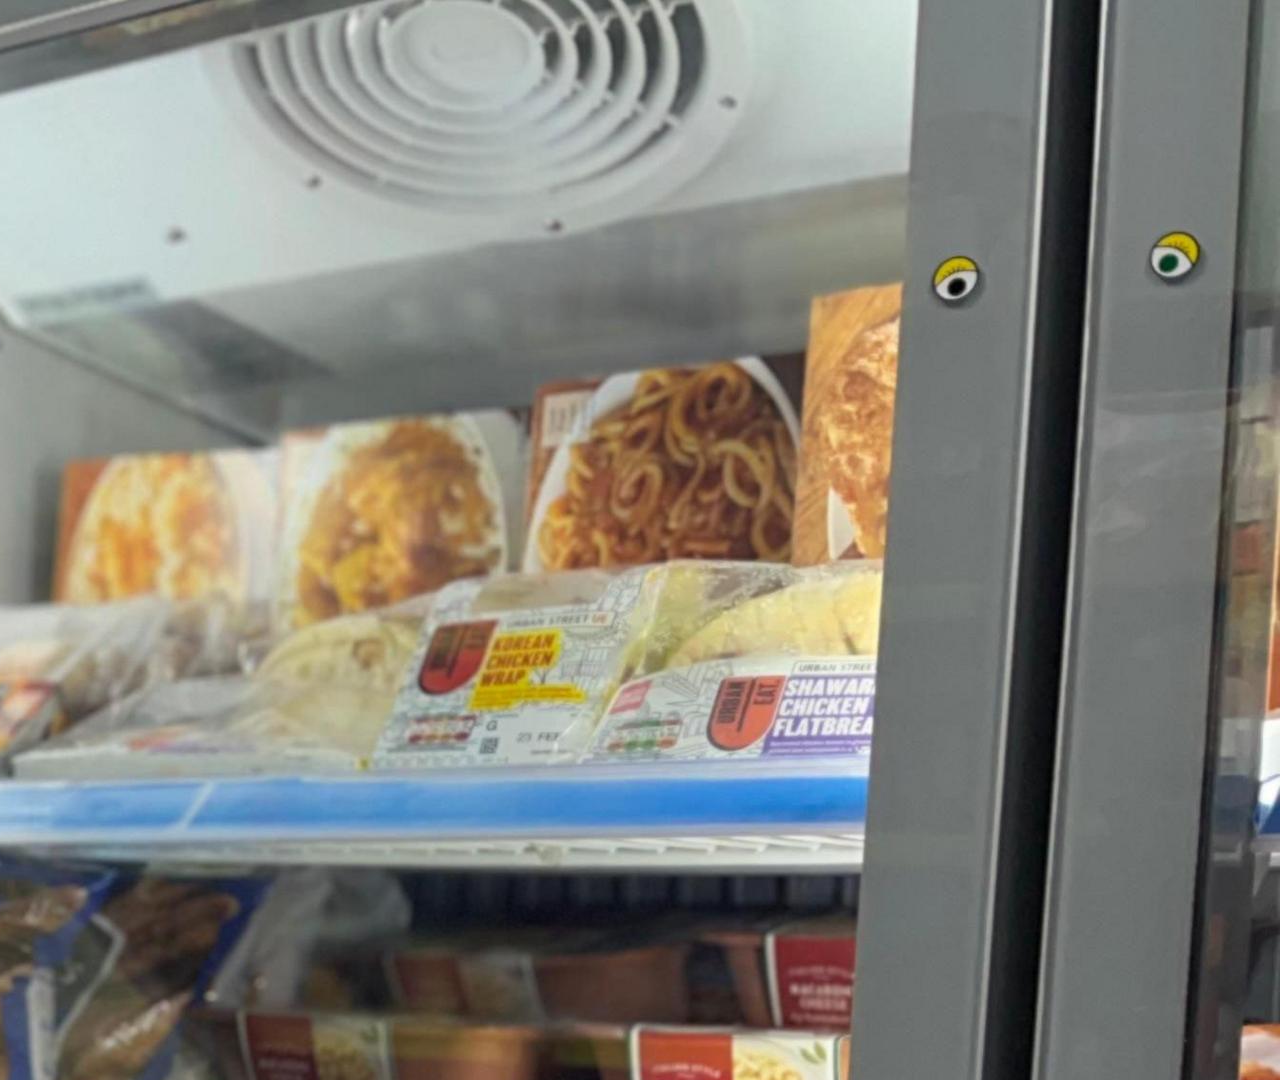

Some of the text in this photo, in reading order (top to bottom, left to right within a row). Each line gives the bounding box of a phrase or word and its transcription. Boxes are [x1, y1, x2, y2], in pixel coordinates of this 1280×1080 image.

[494, 633, 556, 652] KOREAN
[486, 651, 555, 670] CHICKEN
[480, 669, 527, 687] WRAP
[784, 677, 876, 697] SHAWAR
[752, 680, 780, 705] EAT
[778, 697, 871, 717] CHICKEN
[772, 716, 874, 737] FLATBREA
